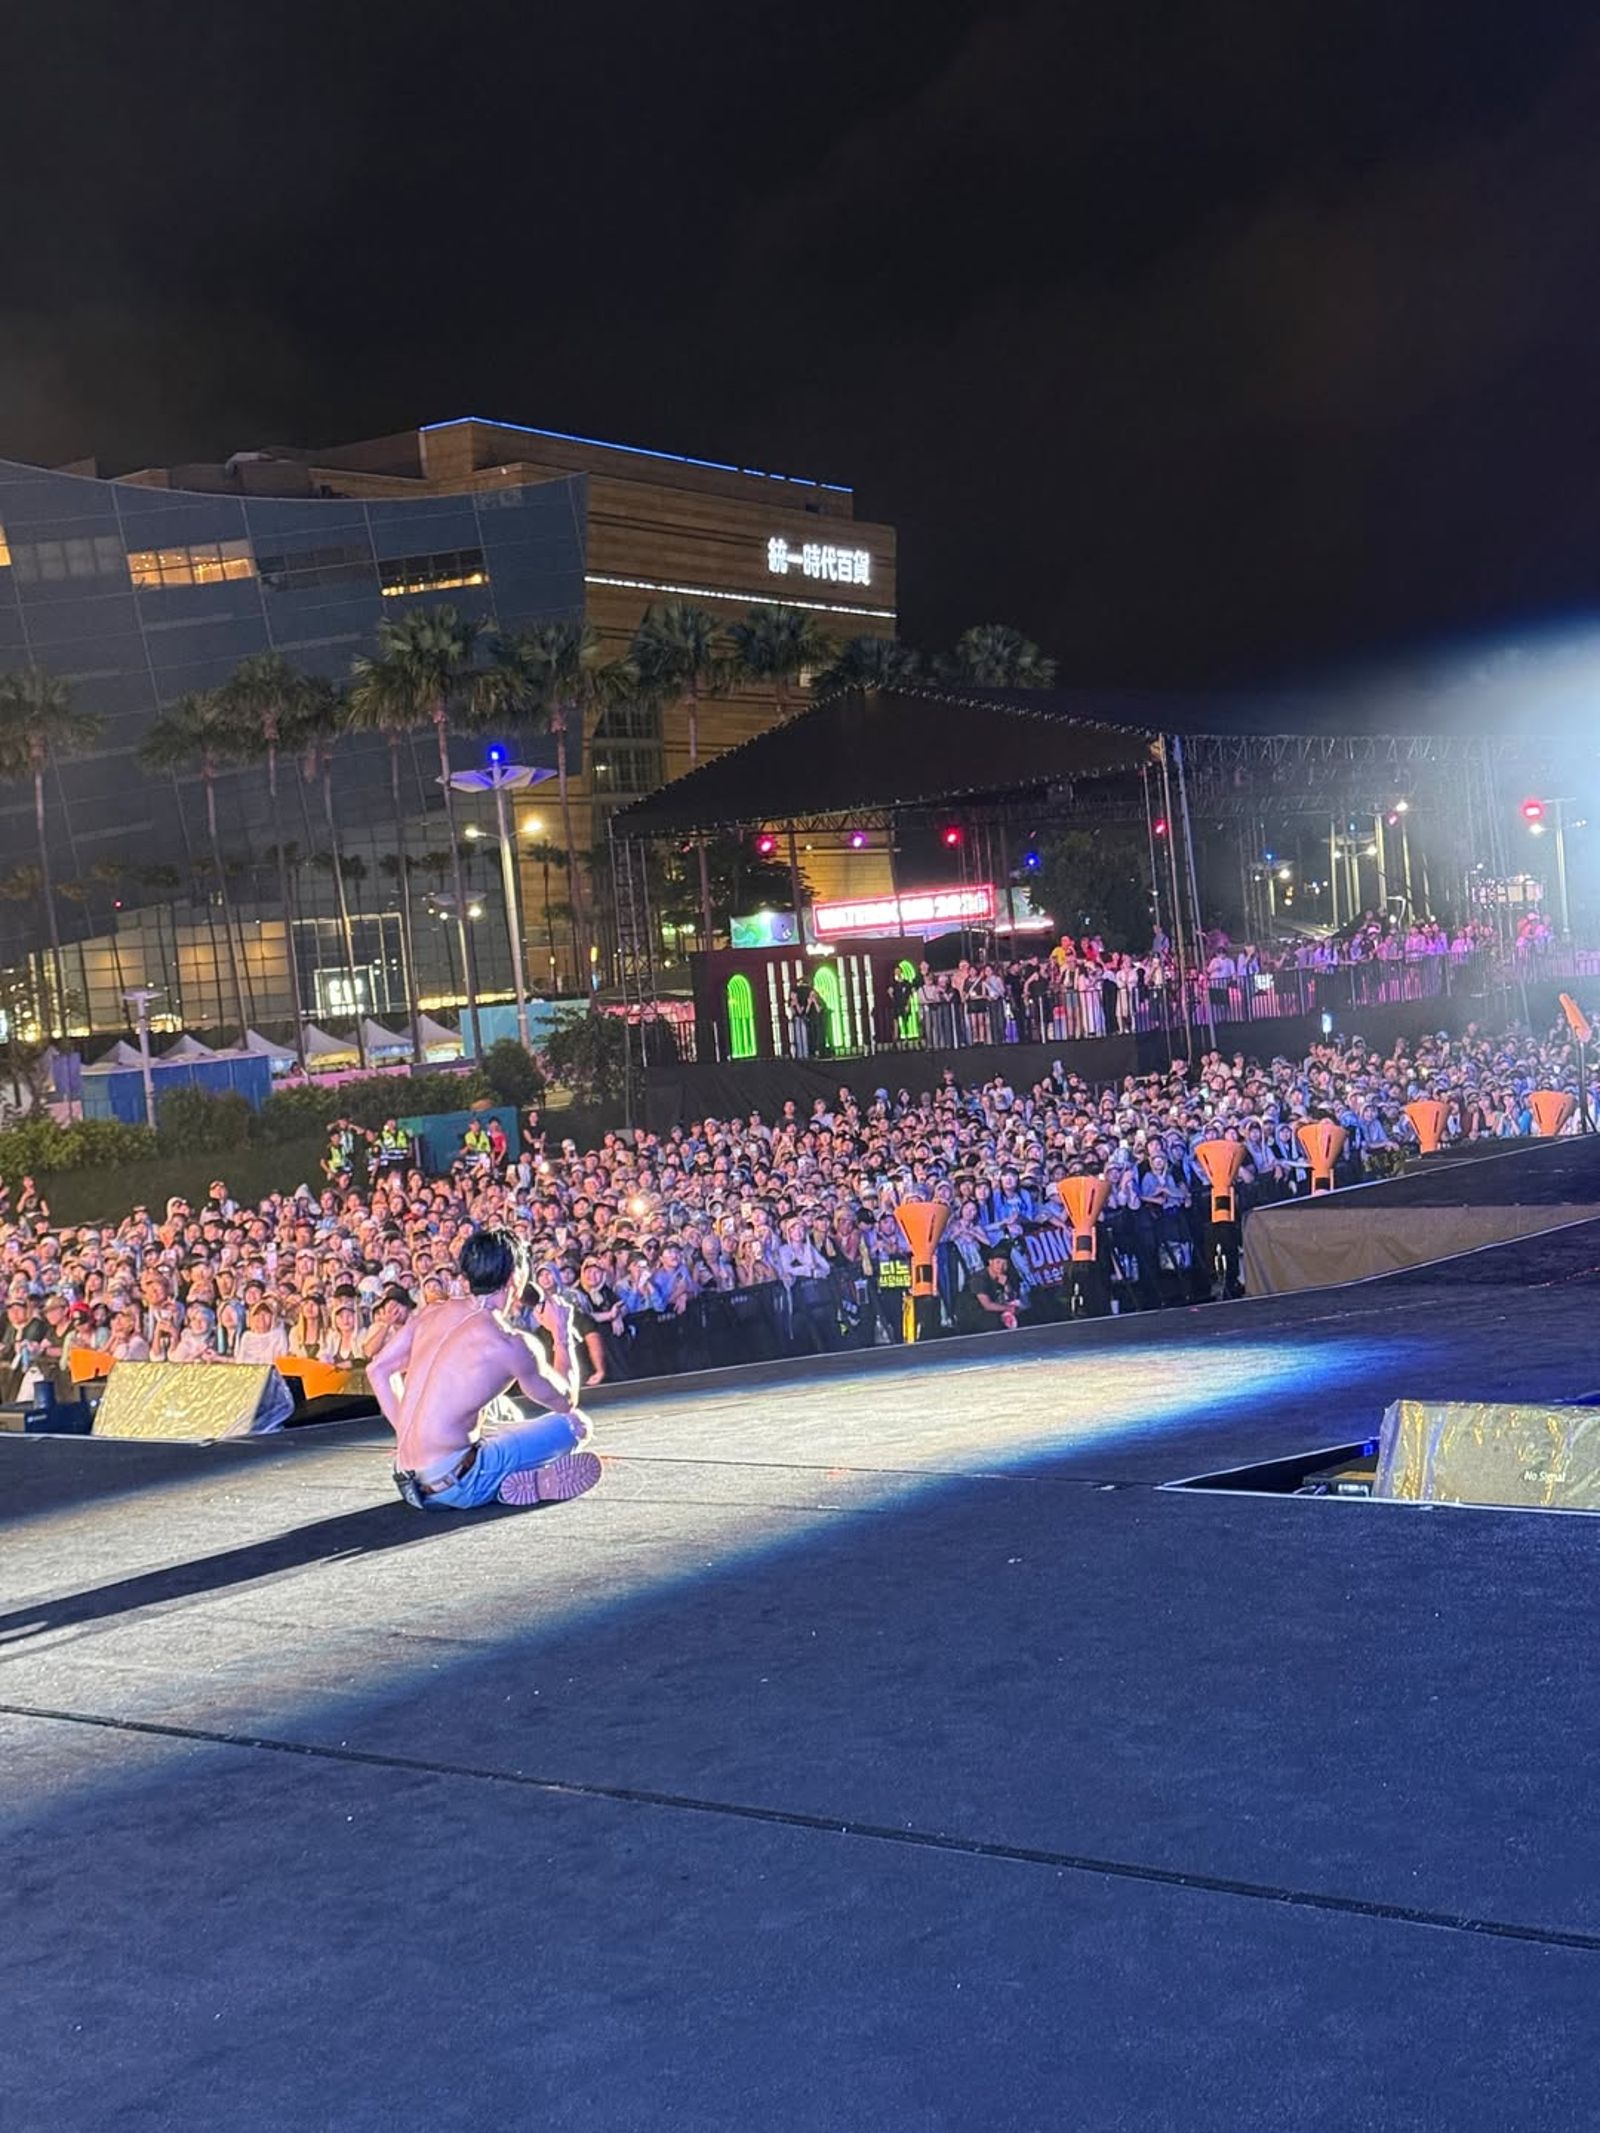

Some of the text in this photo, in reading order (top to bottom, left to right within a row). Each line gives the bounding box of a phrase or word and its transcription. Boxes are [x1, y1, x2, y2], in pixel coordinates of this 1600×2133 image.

[767, 536, 871, 586] 統一時代百貨
[880, 1260, 909, 1275] 디노
[1523, 1470, 1538, 1481] No
